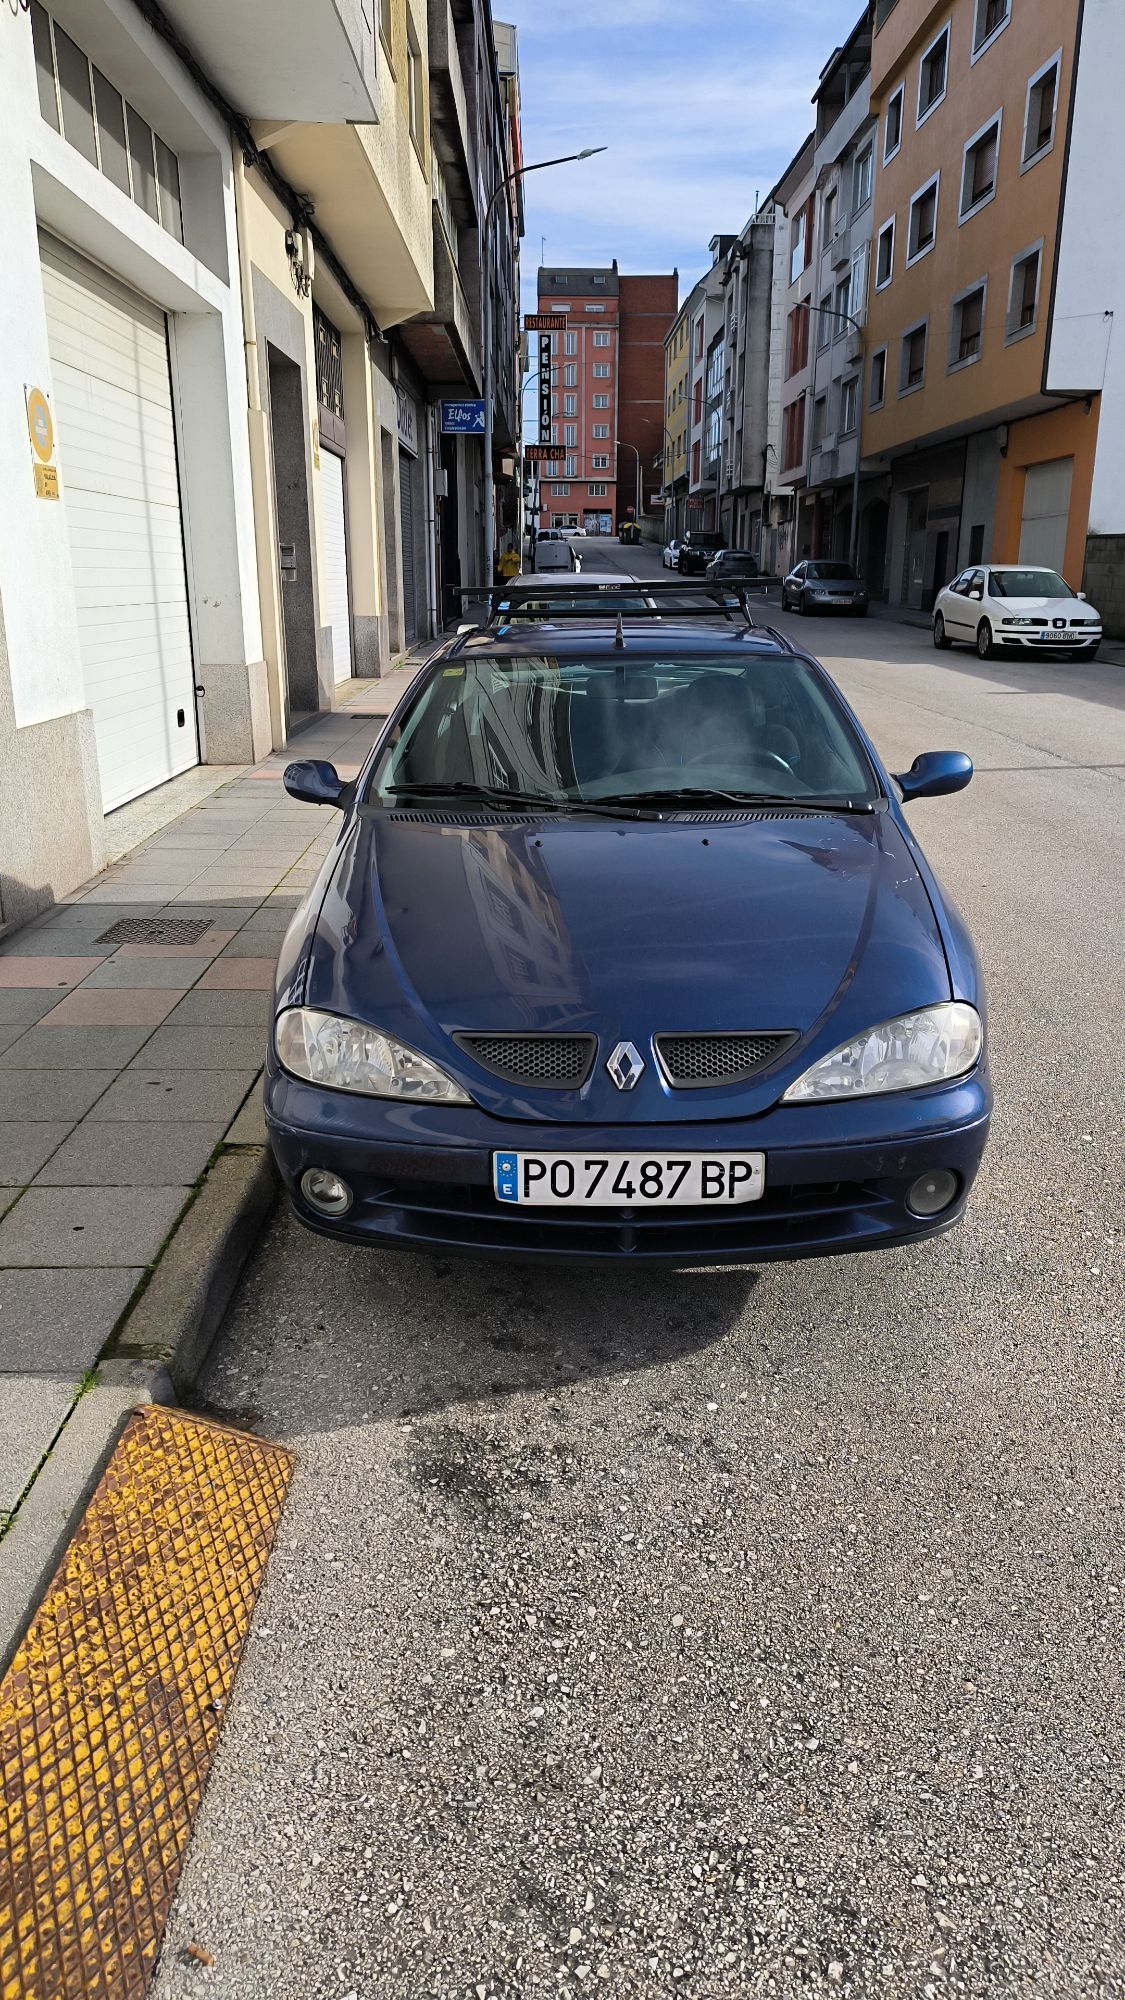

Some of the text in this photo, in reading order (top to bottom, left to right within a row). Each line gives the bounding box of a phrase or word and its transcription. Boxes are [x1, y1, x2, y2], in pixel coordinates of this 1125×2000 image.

[525, 316, 566, 329] RESTAURANTE
[541, 336, 550, 441] PENSIÓN
[447, 408, 471, 421] Elfos
[526, 447, 548, 460] TERRA
[523, 1159, 753, 1199] PO 7487 BP
[502, 1184, 513, 1195] E
